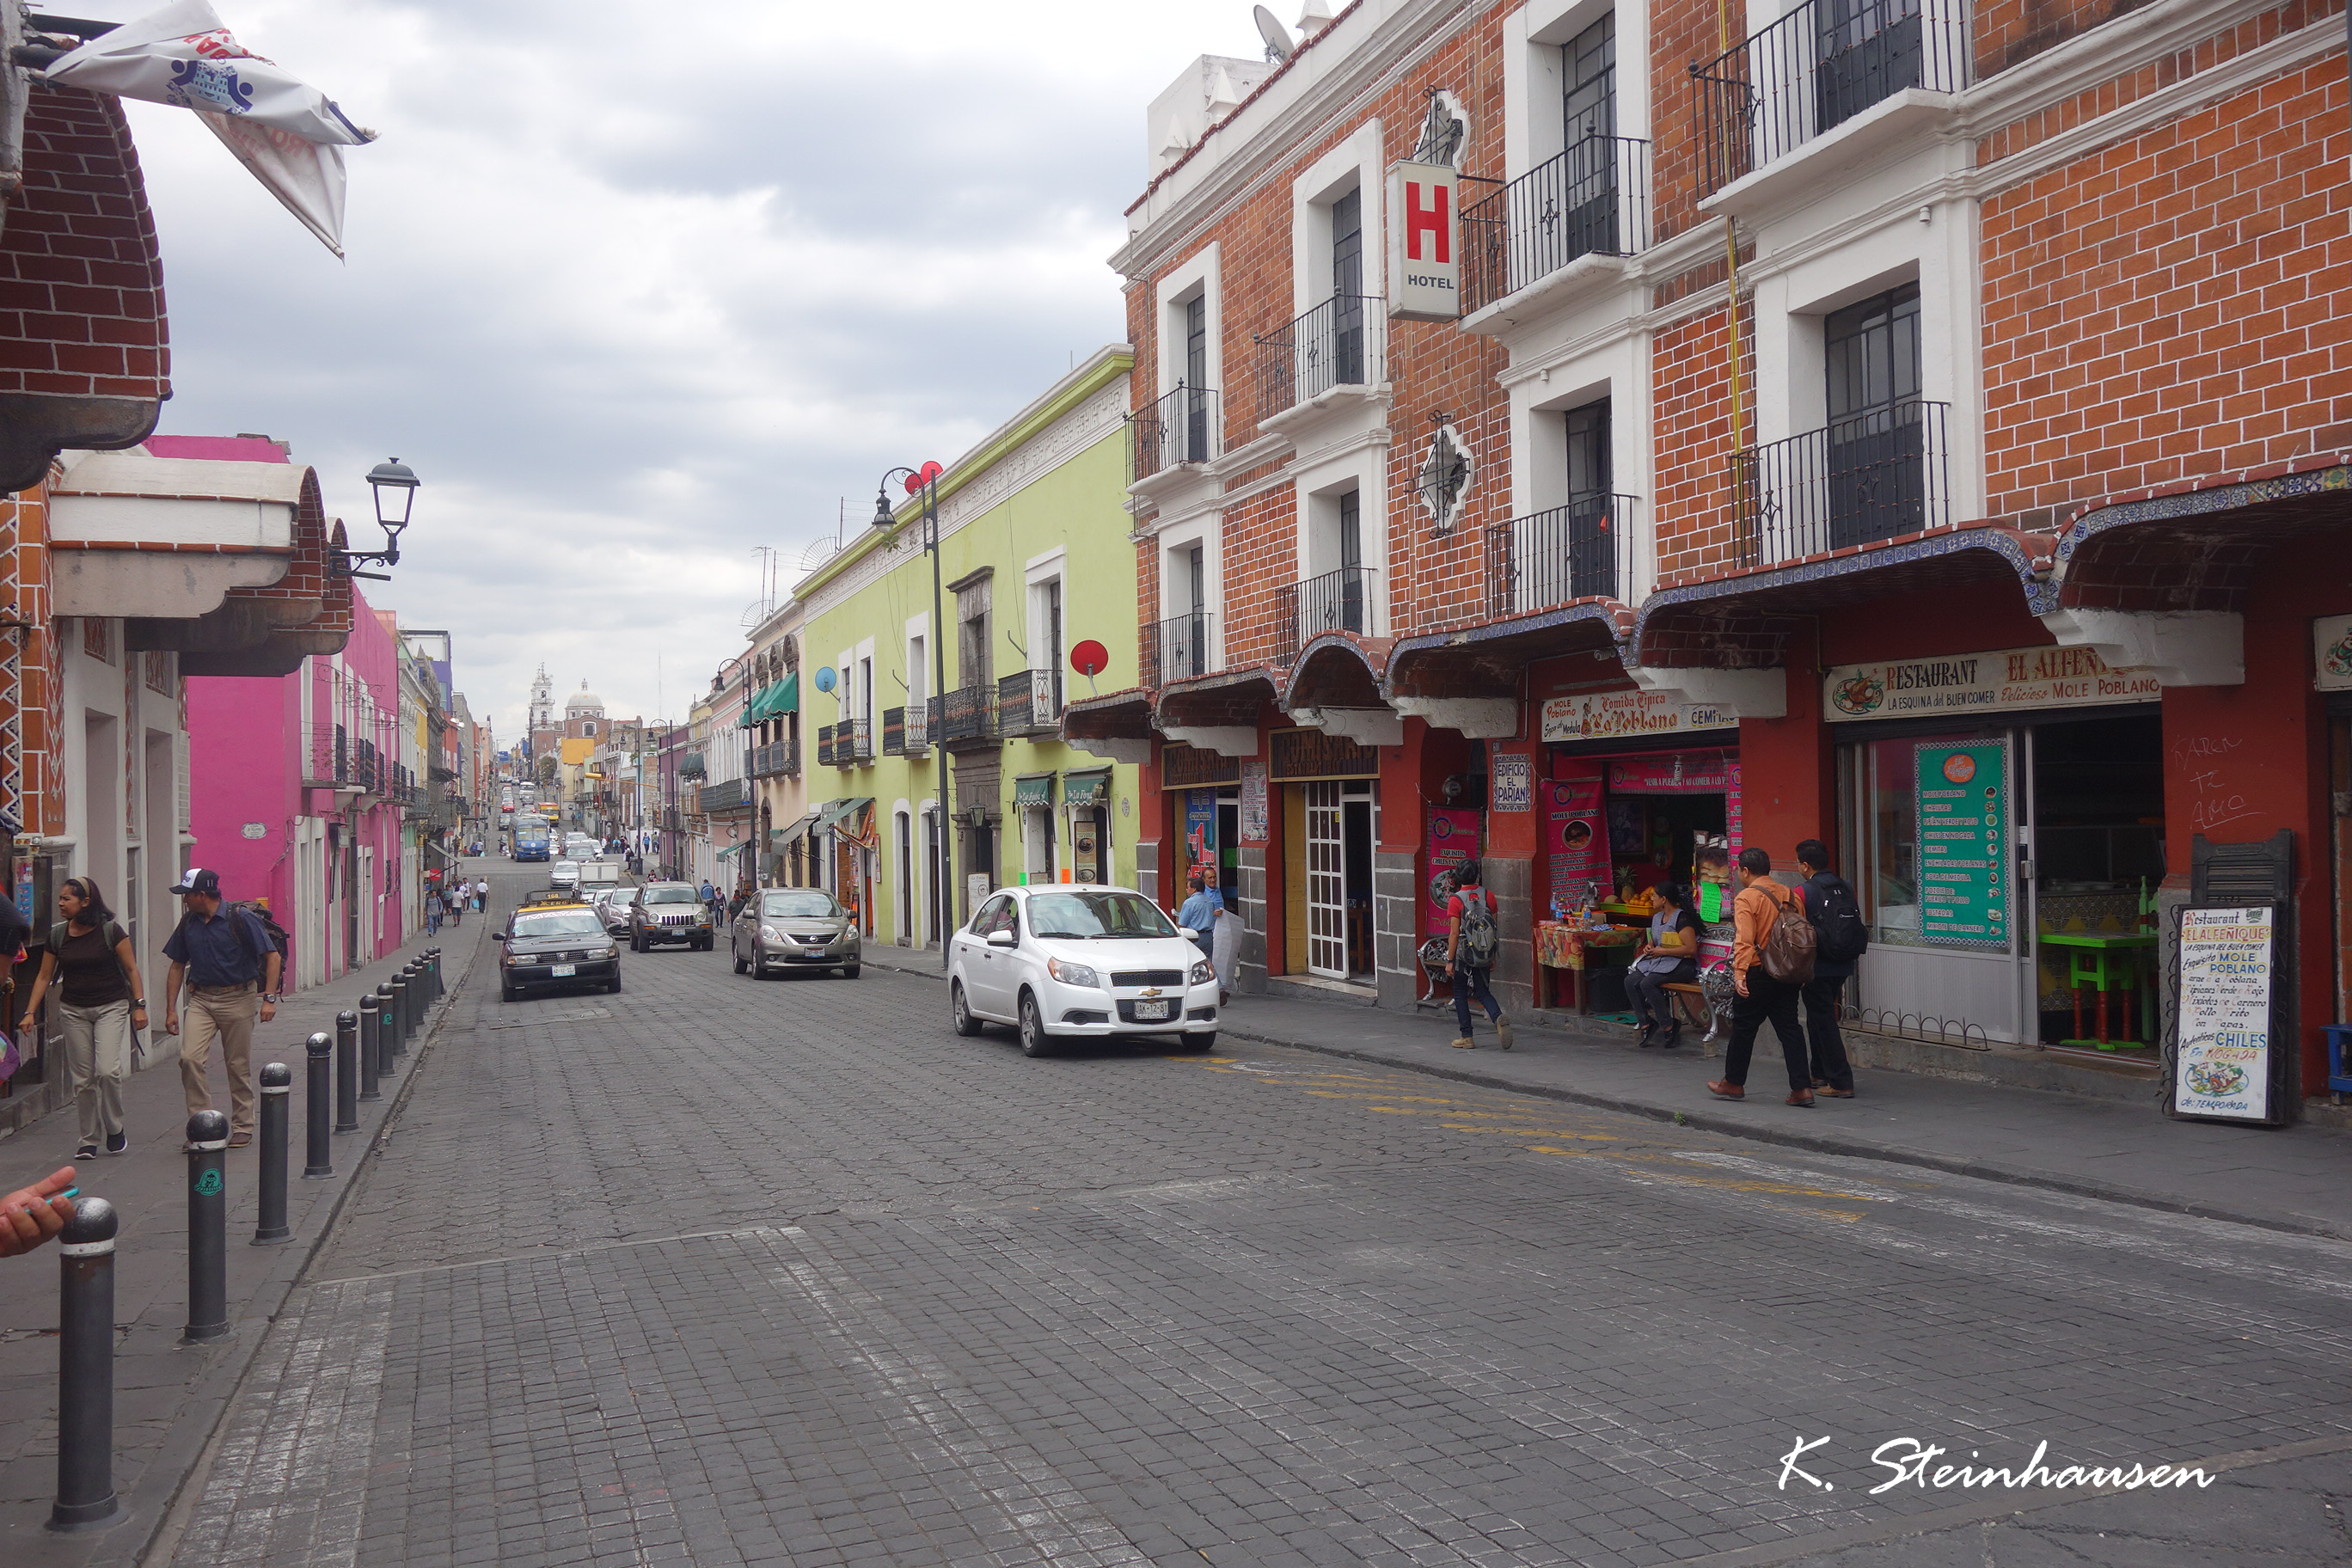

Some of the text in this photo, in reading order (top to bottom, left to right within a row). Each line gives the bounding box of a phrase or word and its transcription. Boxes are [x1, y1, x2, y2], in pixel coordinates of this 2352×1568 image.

[1406, 181, 1449, 263] H
[1407, 273, 1455, 290] HOTEL
[2006, 652, 2029, 683] EL
[1886, 658, 1978, 691] RESTAURANT
[2000, 677, 2160, 701] Delicioso MOLE POBLANO
[1554, 699, 1572, 707] MOLE
[1602, 695, 1634, 713] Comida
[1888, 689, 1995, 710] LA ESQUINA del BUEN COMER
[1547, 706, 1577, 720] Poblano
[1691, 709, 1735, 725] CEMi
[1563, 720, 1581, 734] Medula
[1592, 709, 1678, 736] La Poblana
[1498, 764, 1526, 777] EDIFICIO
[1507, 777, 1516, 787] EL
[1072, 790, 1080, 799] La
[1498, 787, 1526, 802] PARIAN
[1551, 809, 1601, 820] MOLE POBLANO
[1441, 849, 1467, 858] EXQUISITOS
[1432, 857, 1449, 866] CHILES
[1925, 859, 1987, 868] ENCHILADAS POBLANAS
[2184, 912, 2239, 925] Restaurant
[1957, 924, 1985, 933] CARNERO
[2184, 952, 2256, 971] Exquisito MOLE
[2210, 964, 2267, 974] POBLANO
[2223, 974, 2257, 983] Poblana
[2184, 984, 2215, 995] Pipianes
[2216, 984, 2237, 994] Verde
[2245, 984, 2265, 996] Rojo
[2185, 995, 2218, 1006] Mixiotes
[2231, 995, 2267, 1007] Carnero
[1135, 1004, 1167, 1013] UAK-12-81
[2192, 1007, 2250, 1017] Pollo Frito
[2192, 1018, 2207, 1027] Con
[2215, 1032, 2267, 1049] CHILES
[2190, 1047, 2258, 1061] En NOGADA
[2196, 1099, 2249, 1111] TEMPORADA
